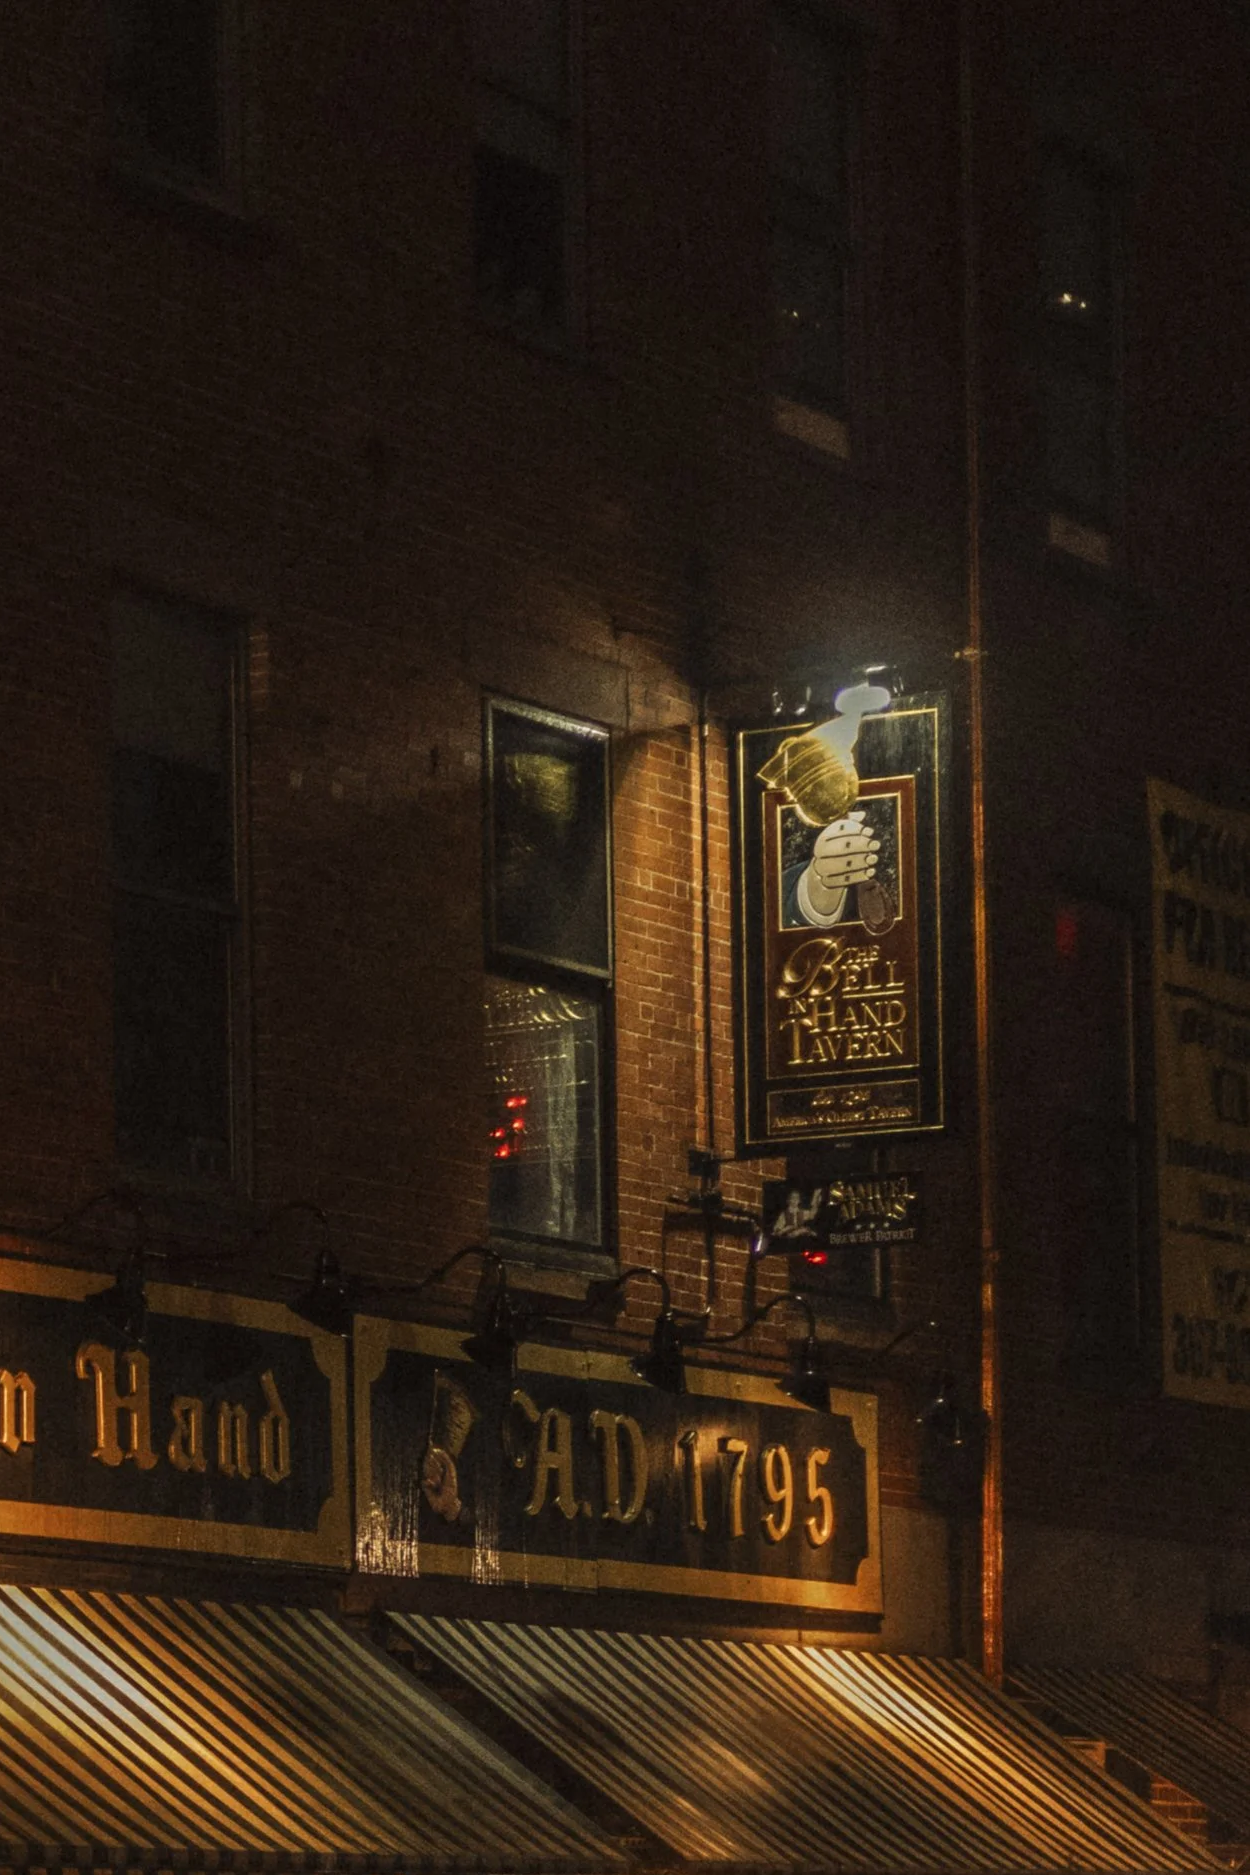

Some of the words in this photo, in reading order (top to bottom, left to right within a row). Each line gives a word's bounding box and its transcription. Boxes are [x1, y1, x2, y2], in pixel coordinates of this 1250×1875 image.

[776, 936, 905, 998] BELL
[846, 945, 880, 964] THE
[779, 1018, 907, 1064] TAVERN
[788, 998, 807, 1015] IN
[808, 997, 906, 1033] HAND
[75, 1342, 293, 1484] Hand
[679, 1430, 833, 1547] 1795
